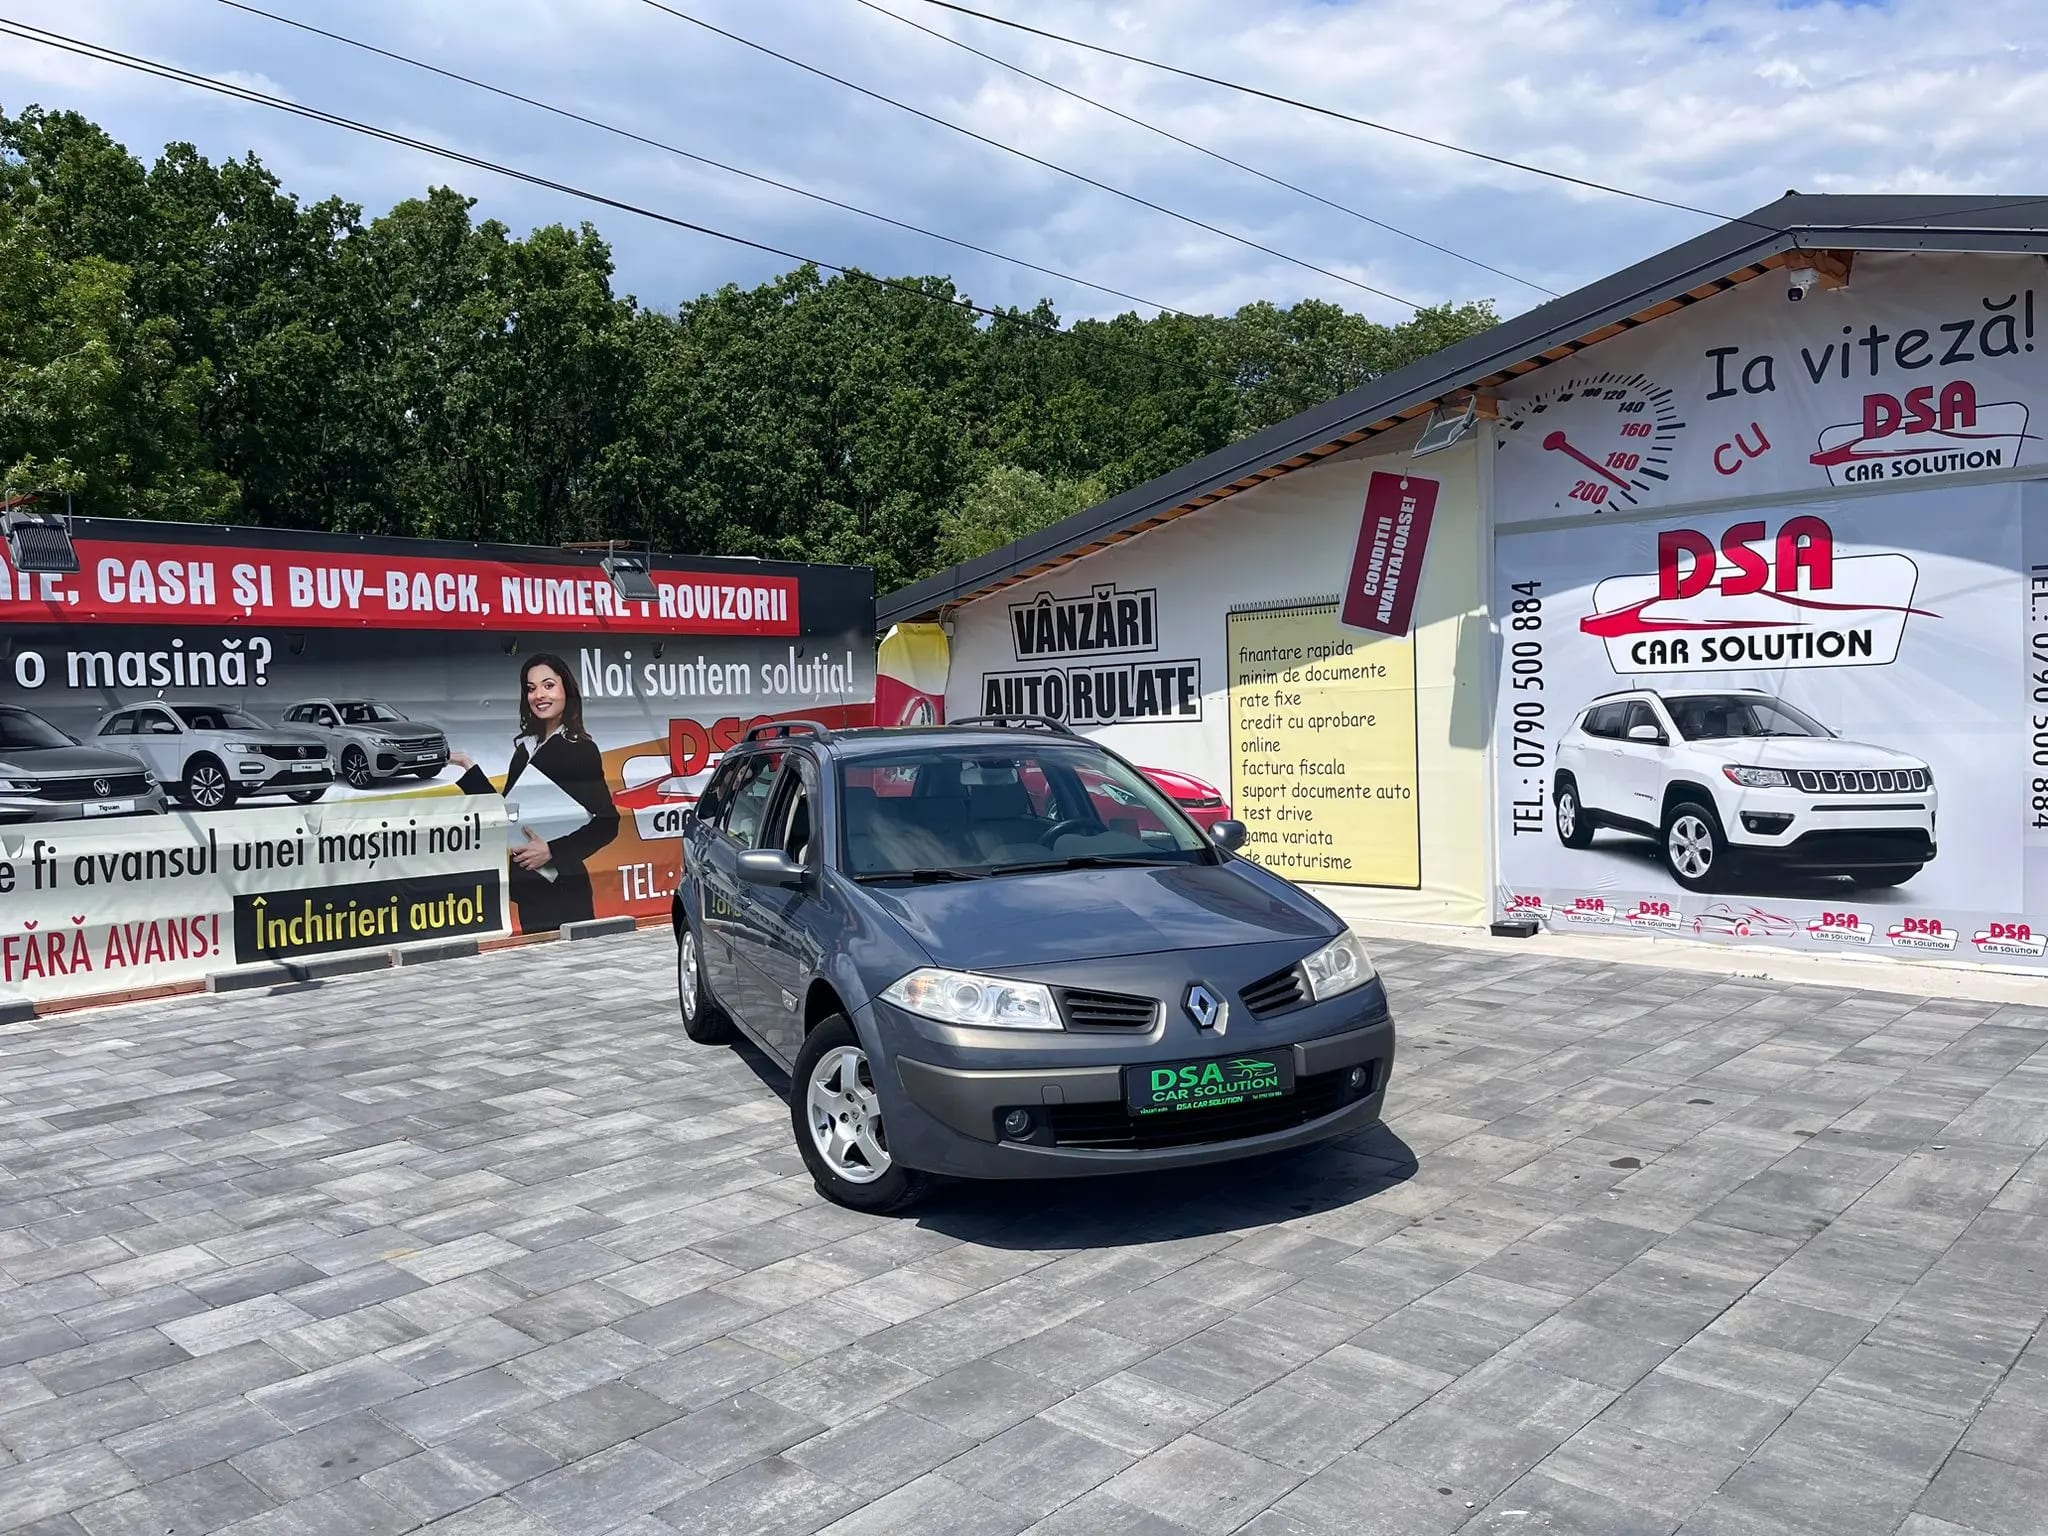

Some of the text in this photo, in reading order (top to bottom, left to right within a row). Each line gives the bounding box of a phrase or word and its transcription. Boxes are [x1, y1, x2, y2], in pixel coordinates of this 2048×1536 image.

[1705, 289, 2035, 401] Ia viteză!
[1602, 390, 1628, 401] 120
[1617, 402, 1646, 413] 140
[1863, 380, 1977, 440] DSA
[1619, 423, 1652, 438] 160
[1713, 421, 1772, 476] cu
[1604, 452, 1641, 471] 180
[1844, 448, 2002, 483] CAR SOLUTION
[1567, 480, 1610, 505] 200
[1363, 516, 1393, 597] CONDITII
[1376, 496, 1418, 625] AVANTAJOASE!
[1657, 515, 1834, 601] DSA
[97, 558, 217, 606] CASH
[232, 563, 274, 617] ȘI
[289, 566, 490, 616] BUY-BACK,
[502, 574, 632, 618] NUMERE
[641, 583, 788, 622] ROVIZORII
[1014, 591, 1153, 655] VÂNZĂRI
[1239, 640, 1354, 664] finantare rapida
[1631, 629, 1873, 666] CAR SOLUTION
[15, 637, 273, 699] o mașină?
[579, 646, 854, 704] Noi suntem soluția!
[1239, 663, 1387, 686] minim de documente
[1073, 666, 1197, 720] RULATE
[1239, 690, 1302, 708] rate fixe
[1511, 580, 1546, 837] TEL.: 0790 500 884
[1240, 711, 1376, 732] credit cu aprobare
[1241, 737, 1281, 753] online
[1242, 758, 1346, 776] factura fiscala
[1242, 781, 1411, 802] suport documente auto
[1243, 805, 1313, 821] test drive
[1283, 829, 1333, 846] variata
[32, 840, 58, 891] fi
[74, 828, 218, 887] avansul
[233, 827, 305, 872] unei
[318, 819, 418, 869] mașini
[429, 812, 482, 854] noi!
[1265, 852, 1353, 870] autoturisme
[618, 862, 676, 902] TEL.:
[1514, 895, 1542, 908] DSA
[1575, 897, 1605, 911] DSA
[1639, 901, 1670, 917] DSA
[251, 884, 485, 951] Închirieri auto!
[1822, 911, 1859, 928] DSA
[1903, 917, 1942, 935] DSA
[1830, 933, 1867, 943] SOLUTION
[1990, 922, 2031, 940] DSA
[3, 914, 221, 983] FĂRĂ AVANS!
[1912, 940, 1950, 950] SOLUTION
[2000, 945, 2039, 956] SOLUTION
[1152, 1063, 1225, 1091] DSA
[1152, 1075, 1279, 1102] CAR SOLUTION
[1176, 1102, 1192, 1110] DSA
[1193, 1101, 1208, 1109] CAR
[1208, 1096, 1243, 1107] SOLUTION
